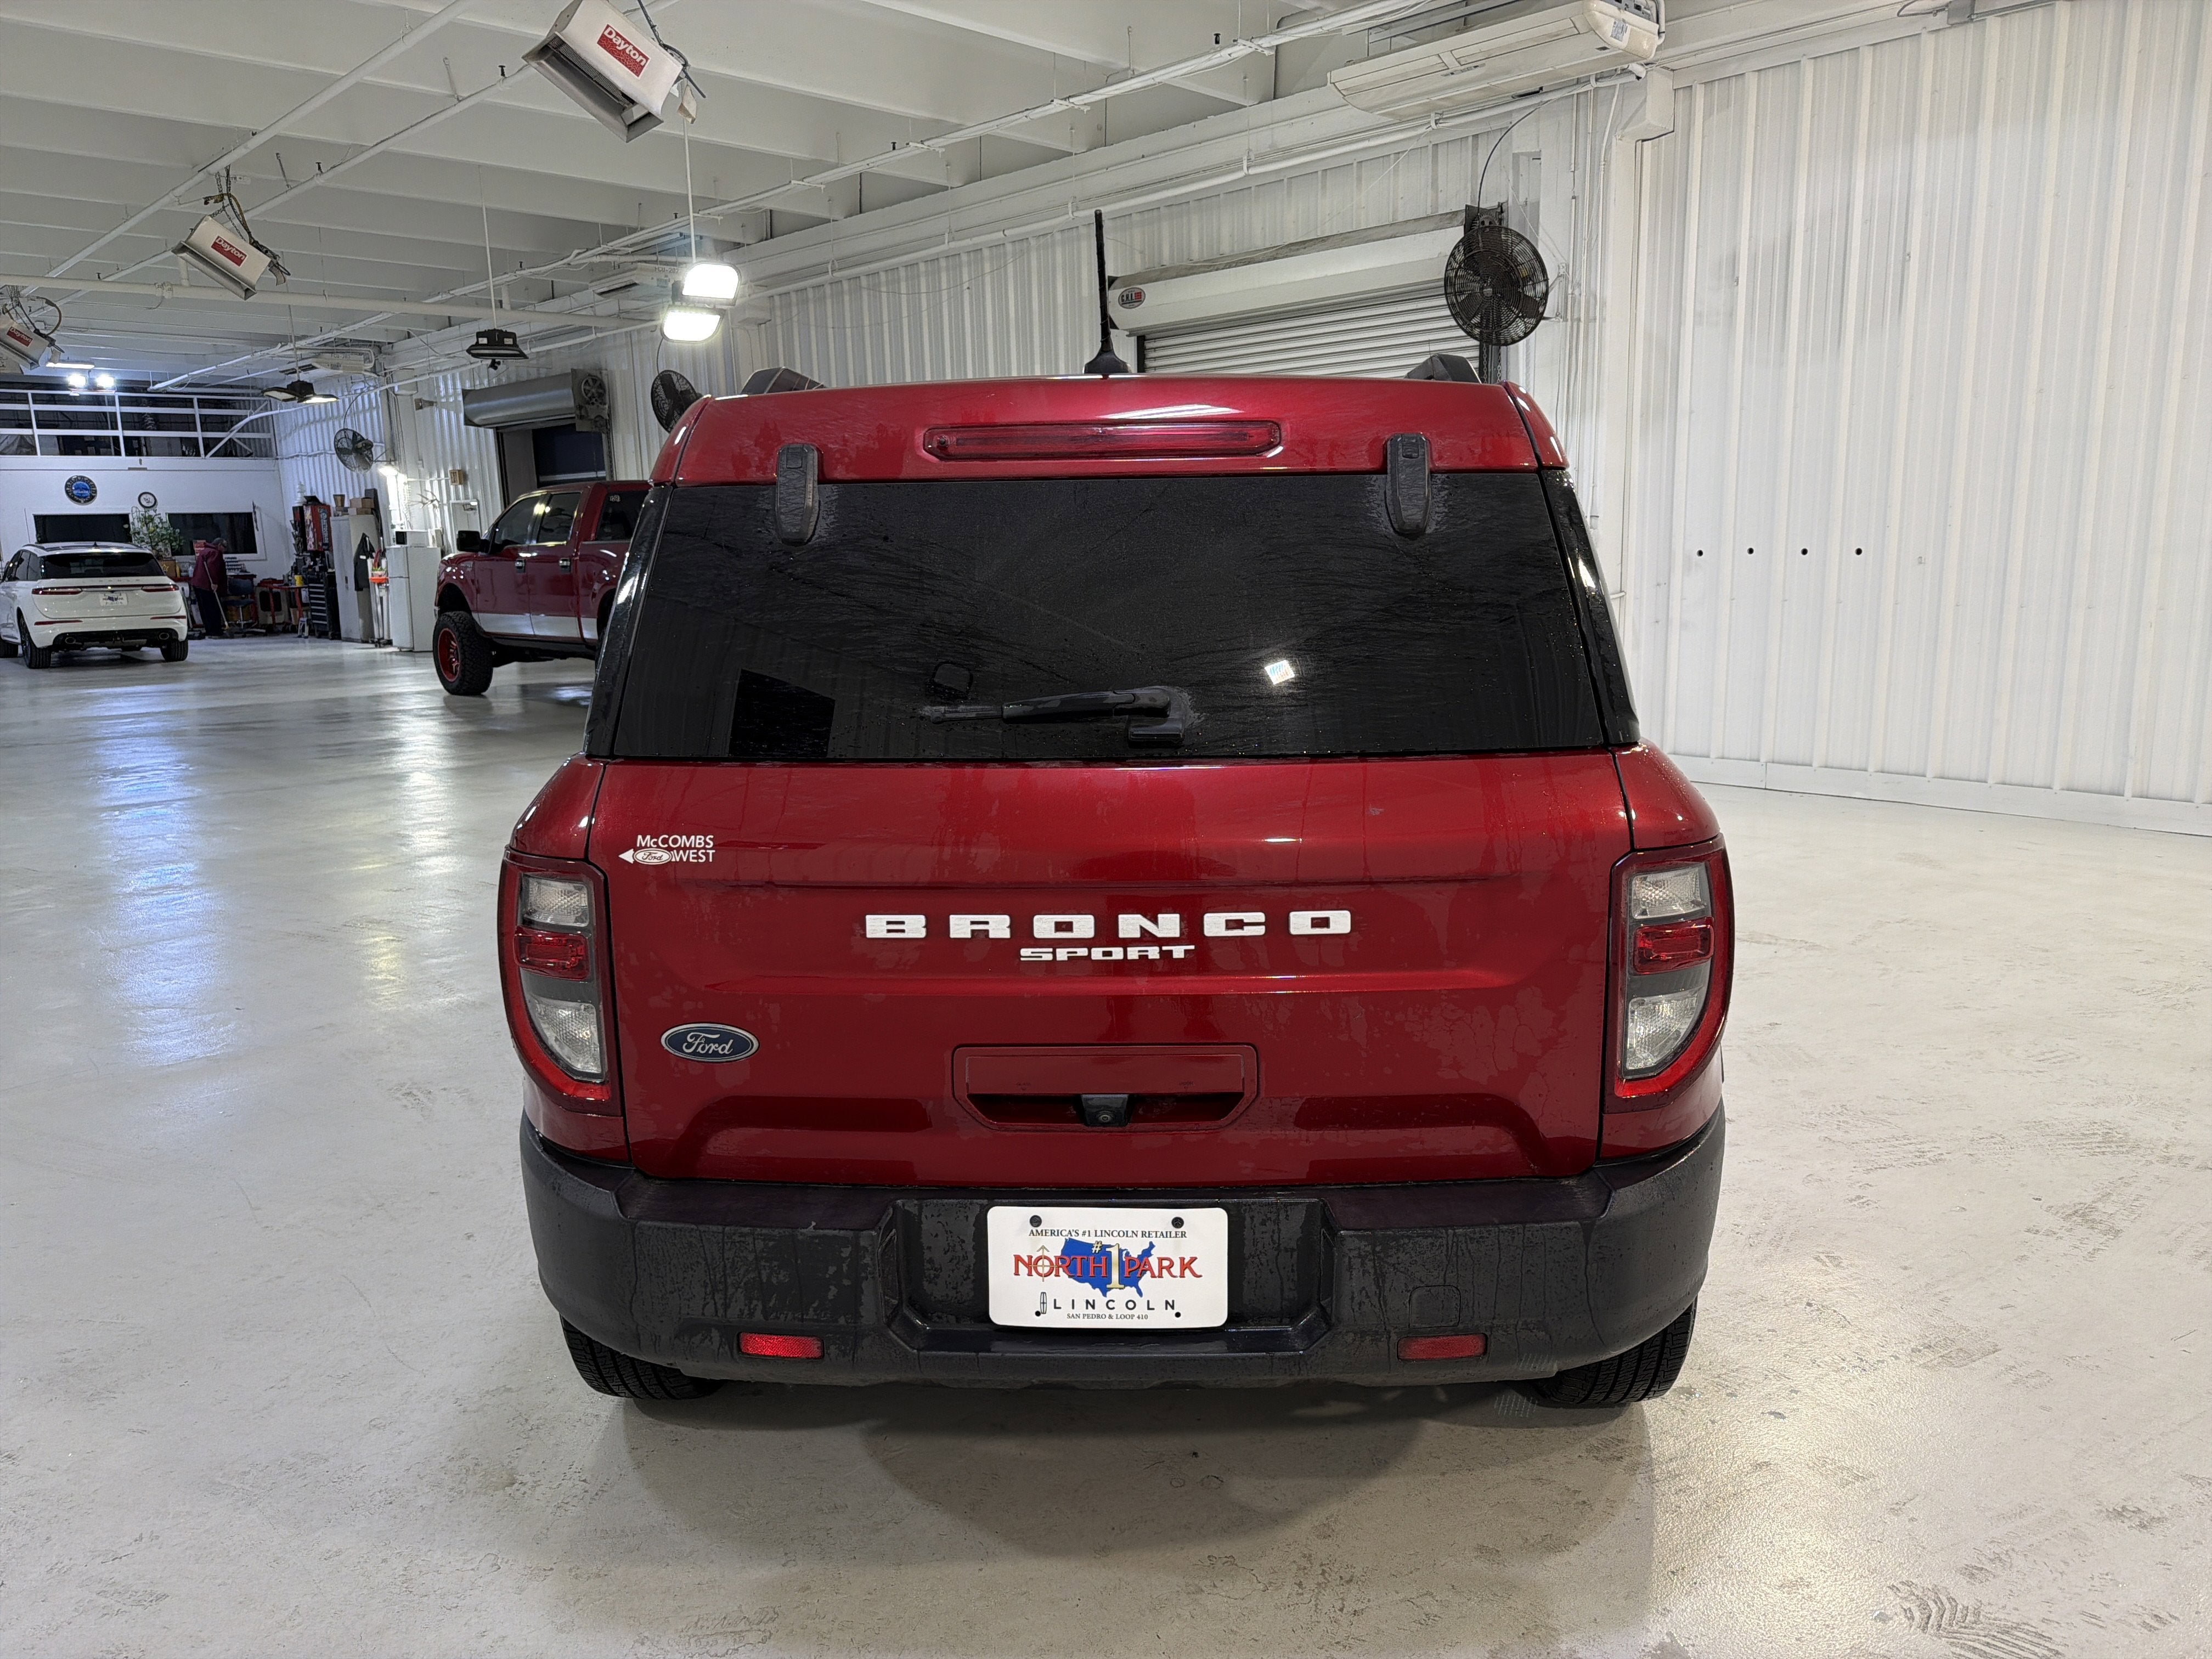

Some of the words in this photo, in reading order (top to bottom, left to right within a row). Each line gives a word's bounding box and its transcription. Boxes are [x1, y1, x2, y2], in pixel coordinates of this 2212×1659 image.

[603, 26, 646, 66] Dayton
[215, 237, 245, 260] Dayton
[9, 328, 32, 342] Dayton
[636, 834, 714, 848] McCOMBS
[641, 852, 663, 861] Ford
[673, 850, 715, 862] WEST
[865, 910, 1351, 939] BRONCO
[1020, 945, 1195, 962] SPORT
[682, 1032, 733, 1054] Ford
[1029, 1229, 1079, 1237] AMERICA'S
[1094, 1230, 1138, 1238] LINCOLN
[1013, 1254, 1108, 1278] NORTH
[1124, 1256, 1203, 1278] PARK
[1053, 1299, 1175, 1311] LINCOLN
